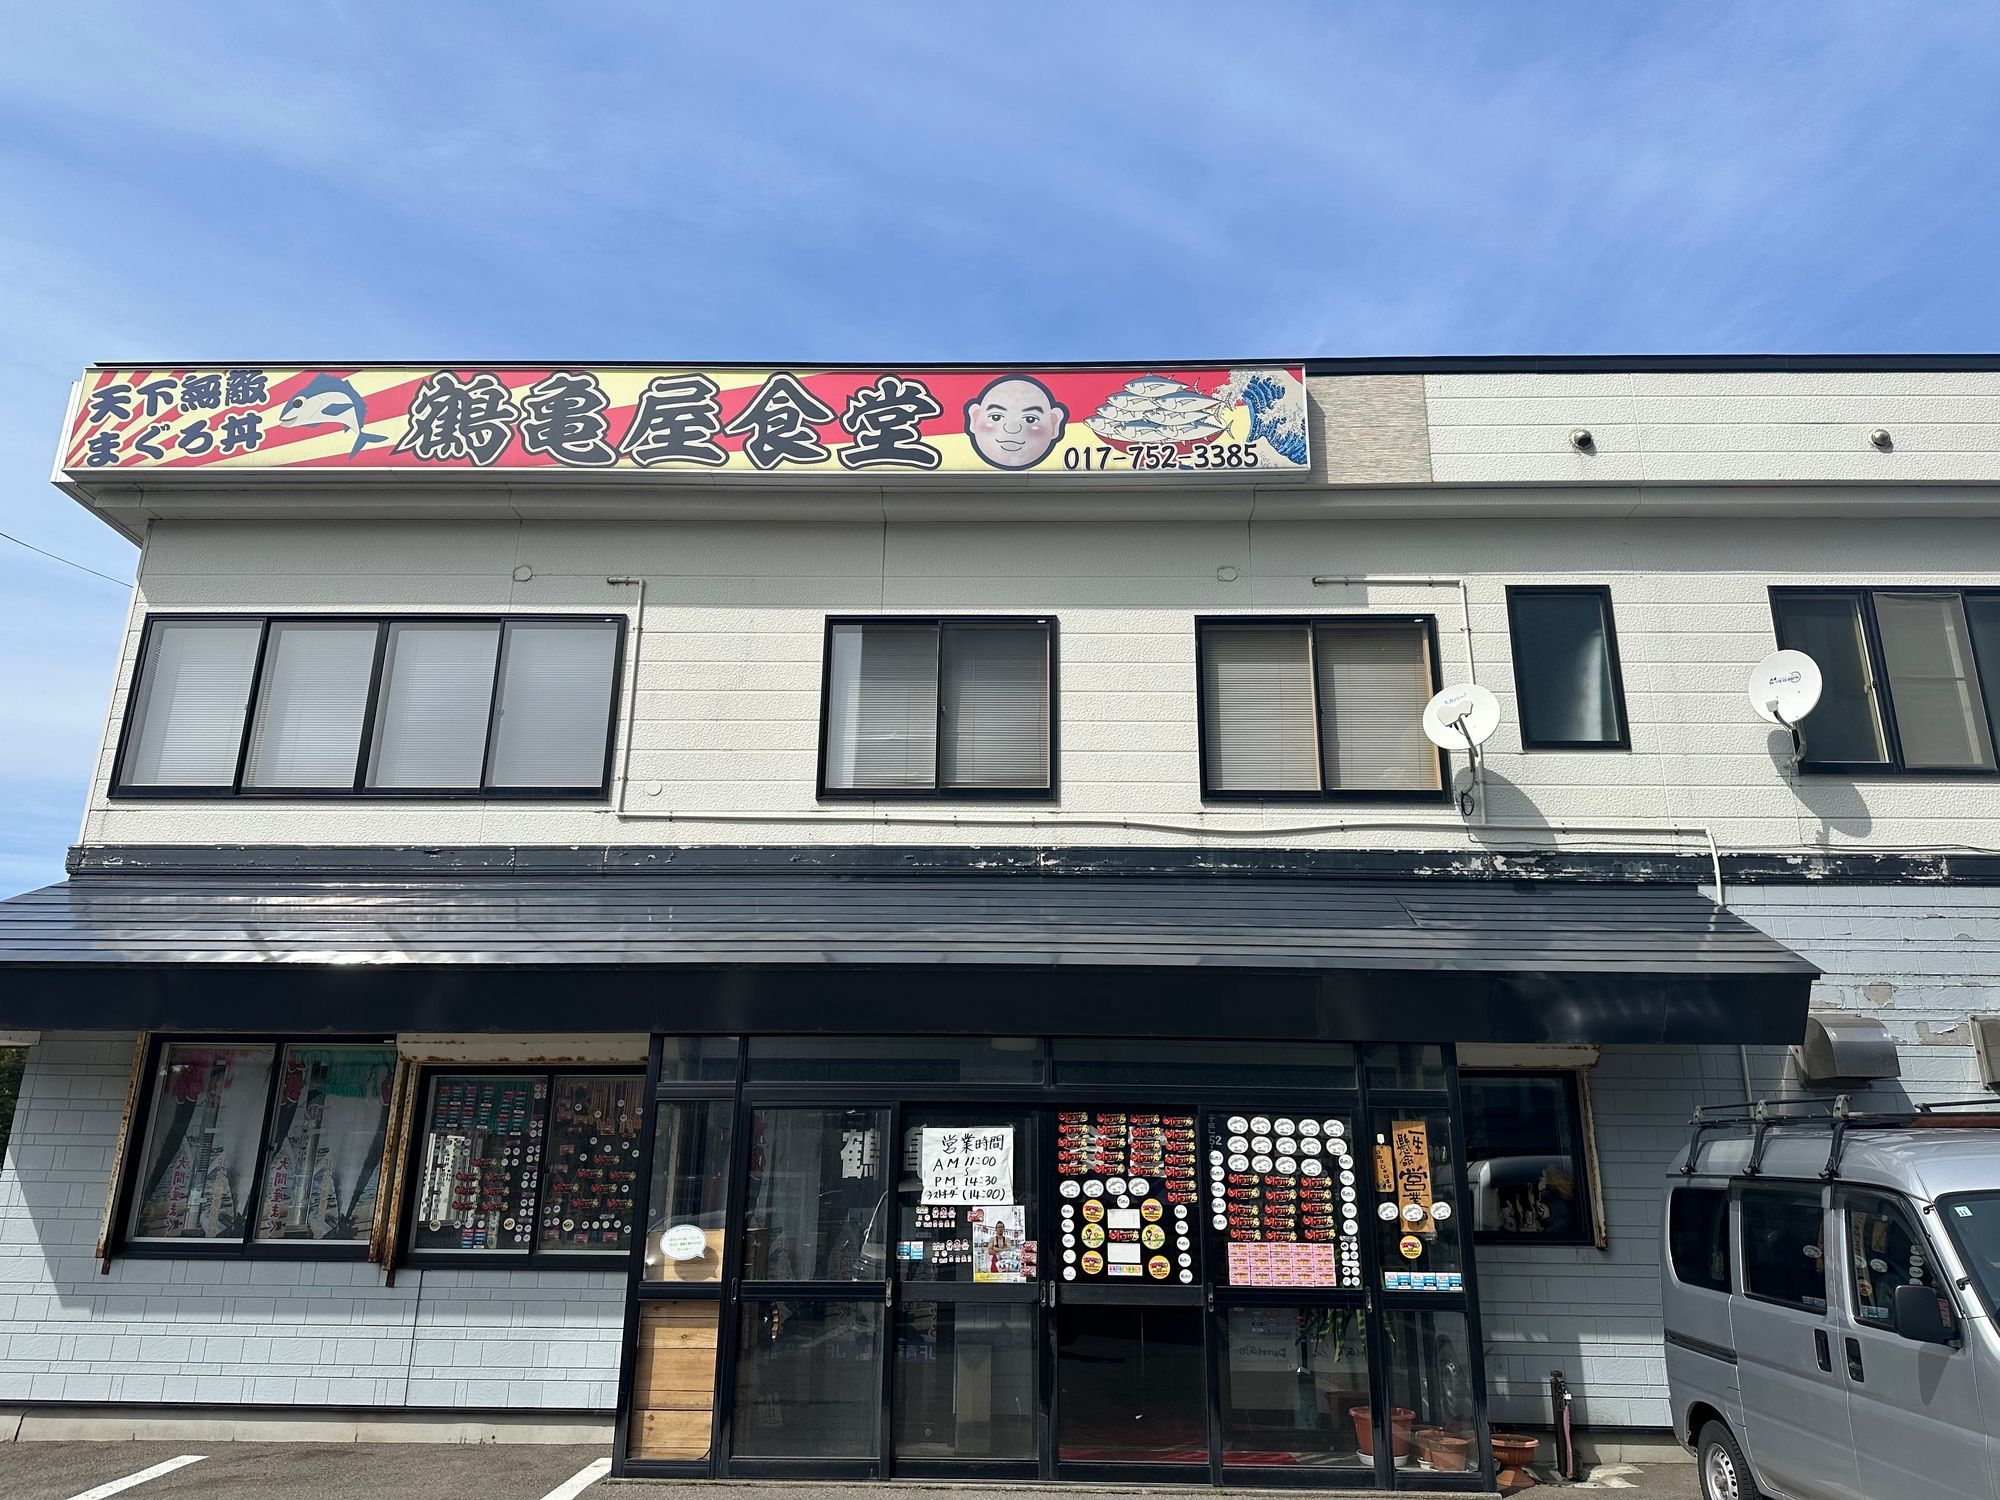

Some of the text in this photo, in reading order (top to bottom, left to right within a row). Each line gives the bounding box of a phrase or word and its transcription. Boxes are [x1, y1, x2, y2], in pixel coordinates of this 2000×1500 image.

[389, 369, 943, 470] 鶴亀屋食堂
[86, 412, 264, 467] まぐろ丼
[1064, 443, 1259, 471] 017-752-3385
[941, 1133, 1004, 1155] 営業時間
[1407, 1129, 1425, 1156] 一生
[932, 1156, 997, 1172] AM 11:00
[934, 1175, 998, 1187] PM 14:30
[962, 1187, 1006, 1202] (14:00)
